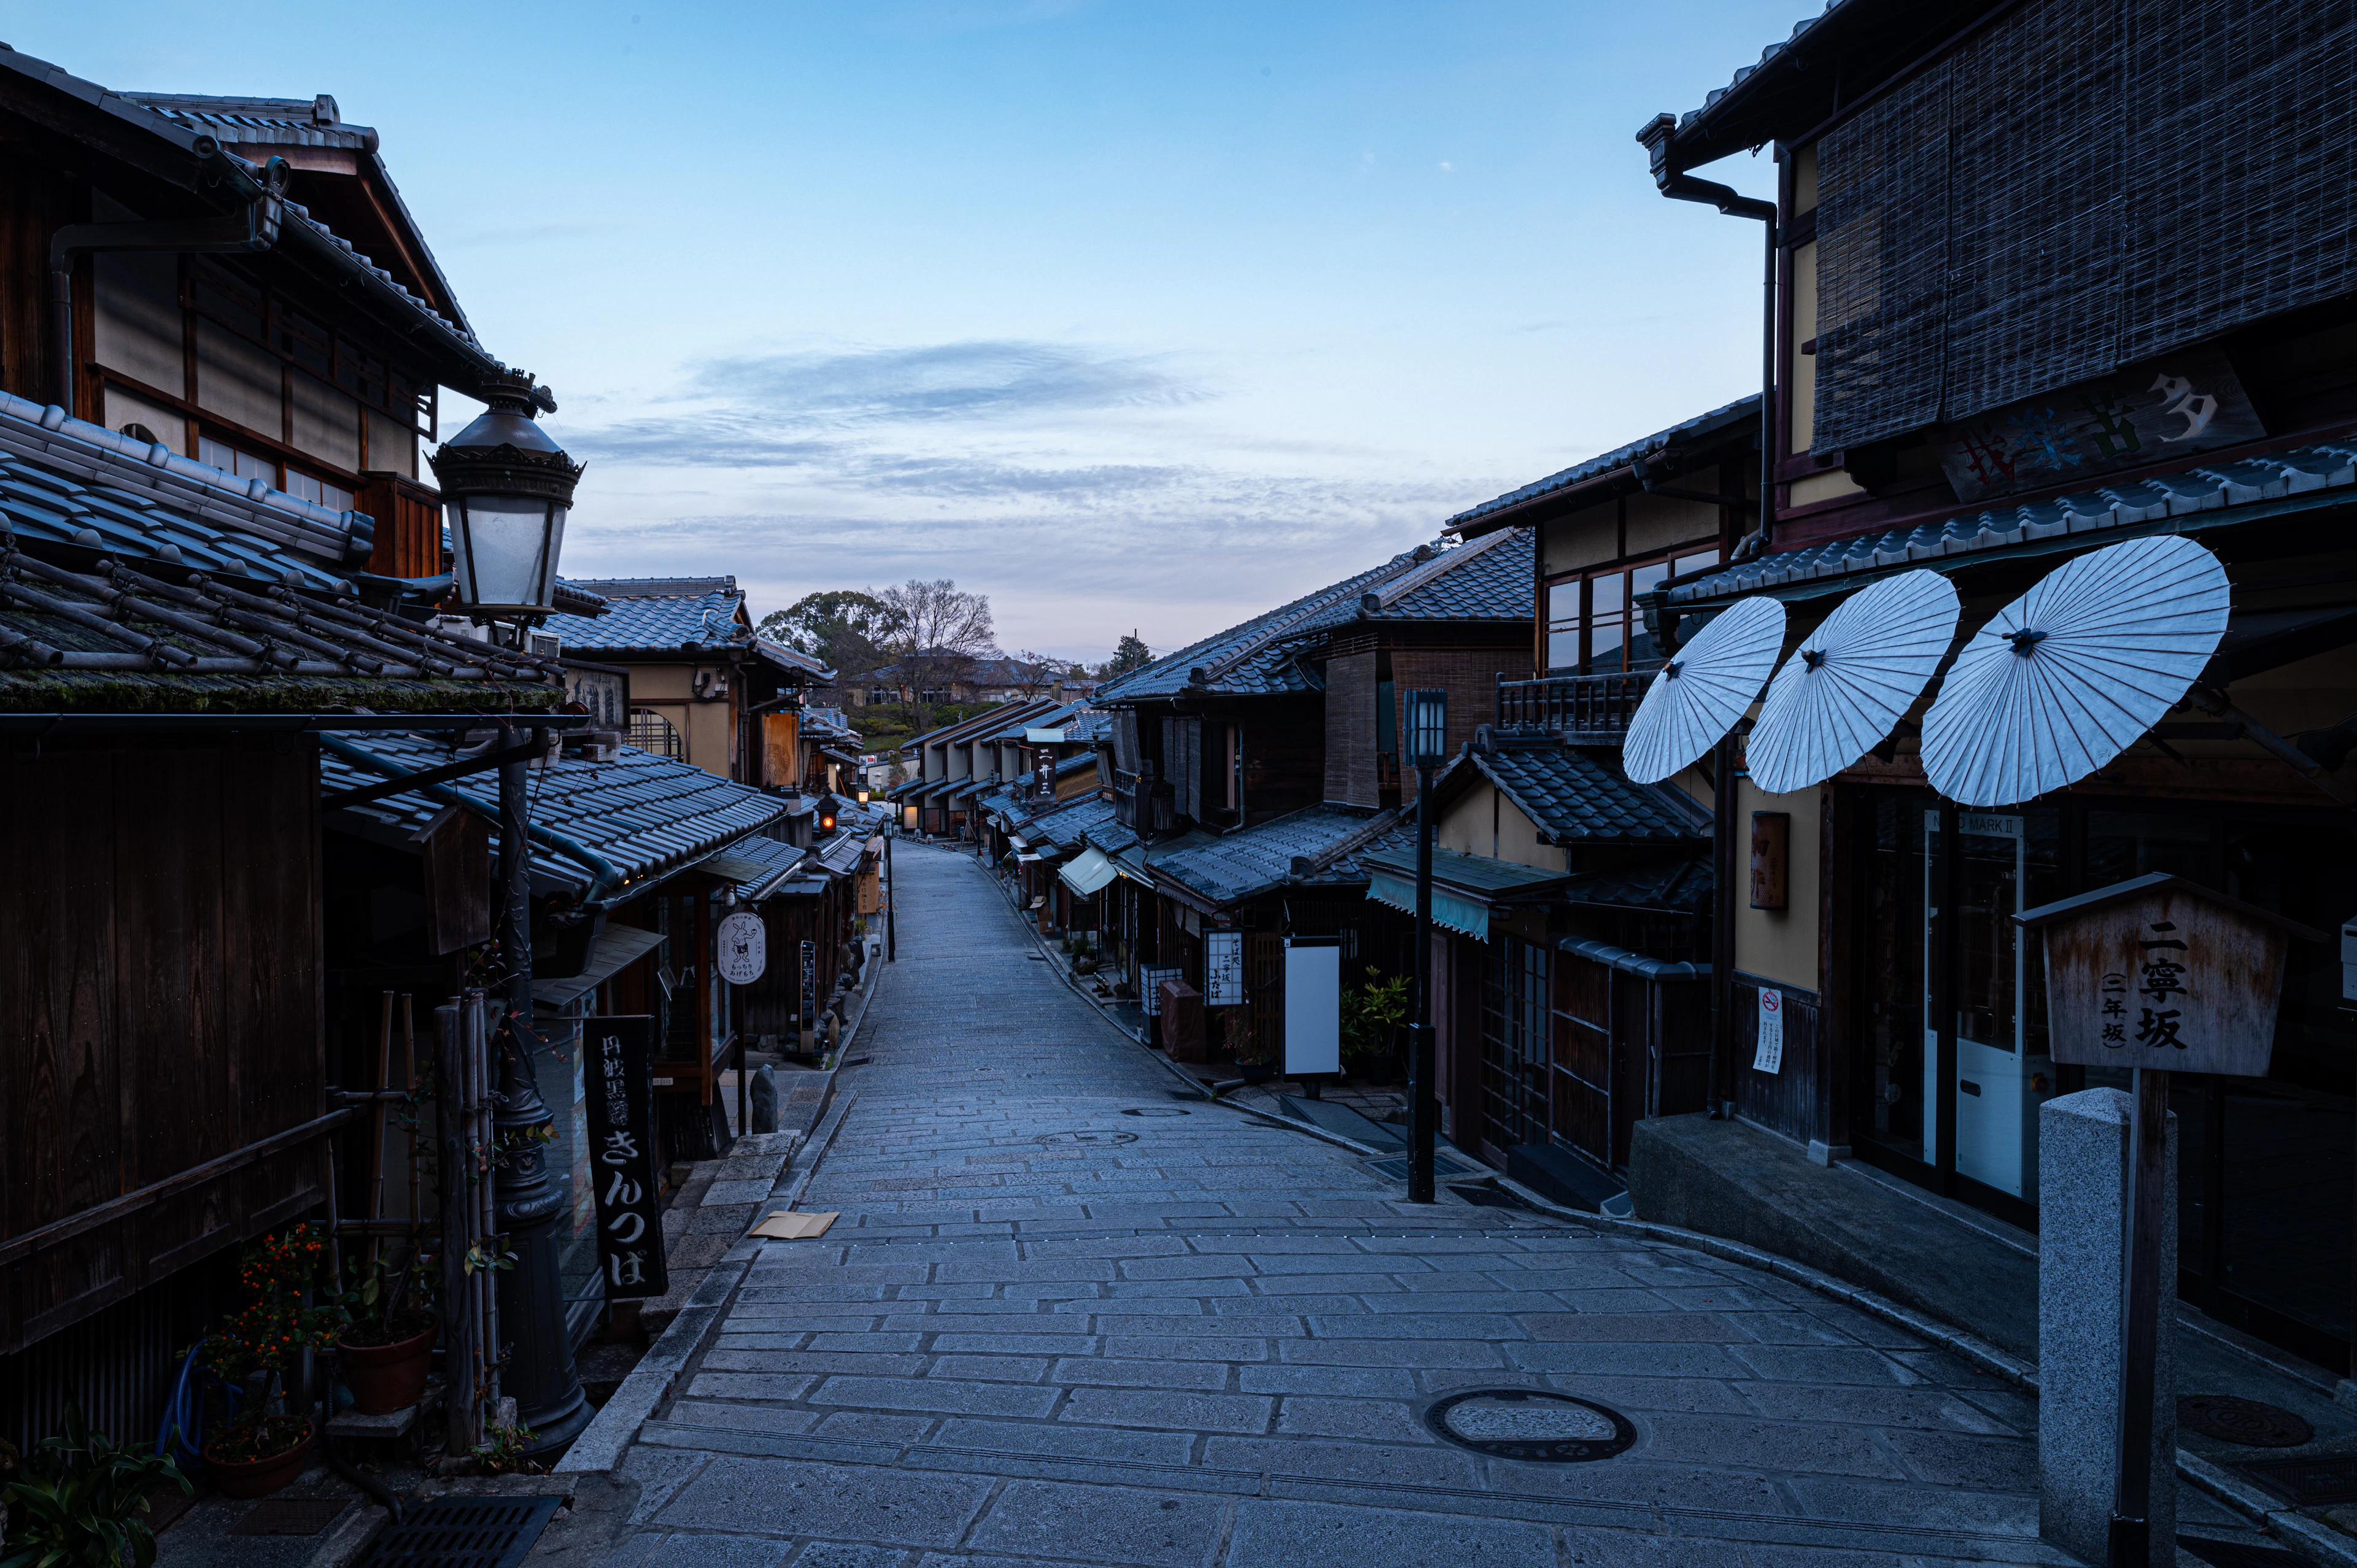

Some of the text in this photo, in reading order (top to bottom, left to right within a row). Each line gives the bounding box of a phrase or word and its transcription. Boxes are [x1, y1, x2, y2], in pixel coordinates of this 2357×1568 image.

[1953, 373, 2218, 485] 我楽苦多
[1039, 748, 1053, 795] 二井三
[1970, 817, 2002, 833] MARK
[1231, 938, 1240, 966] そば処
[1210, 969, 1221, 999] ふたば
[1221, 956, 1231, 983] 二寧坂
[2135, 921, 2189, 1050] 二寧坂
